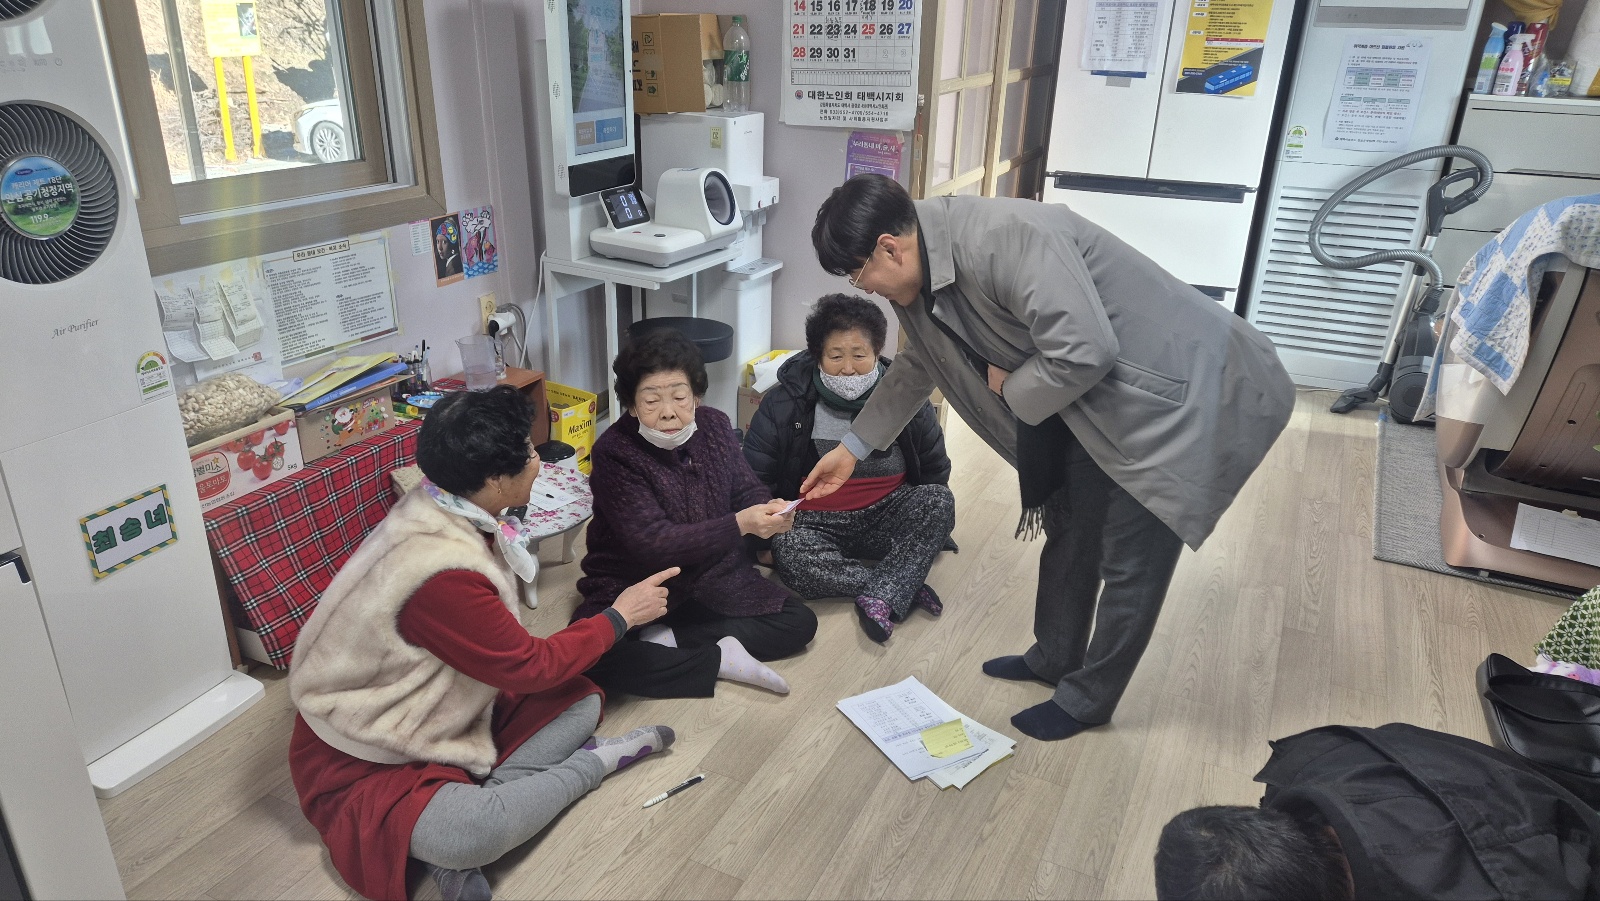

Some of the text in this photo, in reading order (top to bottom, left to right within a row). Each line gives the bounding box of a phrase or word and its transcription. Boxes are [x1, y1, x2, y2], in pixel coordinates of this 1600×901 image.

[794, 0, 806, 11] 14
[810, 0, 822, 12] 15
[828, 0, 840, 12] 16
[846, 0, 858, 12] 17
[882, 0, 894, 11] 19
[898, 0, 912, 10] 20
[793, 24, 804, 34] 21
[810, 24, 822, 35] 22
[826, 24, 840, 35] 23
[844, 24, 857, 35] 24
[862, 24, 875, 35] 25
[880, 24, 893, 35] 26
[898, 23, 912, 34] 27
[793, 47, 806, 58] 28
[810, 48, 822, 58] 29
[827, 48, 839, 58] 30
[844, 48, 856, 58] 31
[808, 90, 904, 102] 대한노인회 태백시지회
[51, 318, 99, 339] Air Purifier
[568, 419, 592, 435] Maxim
